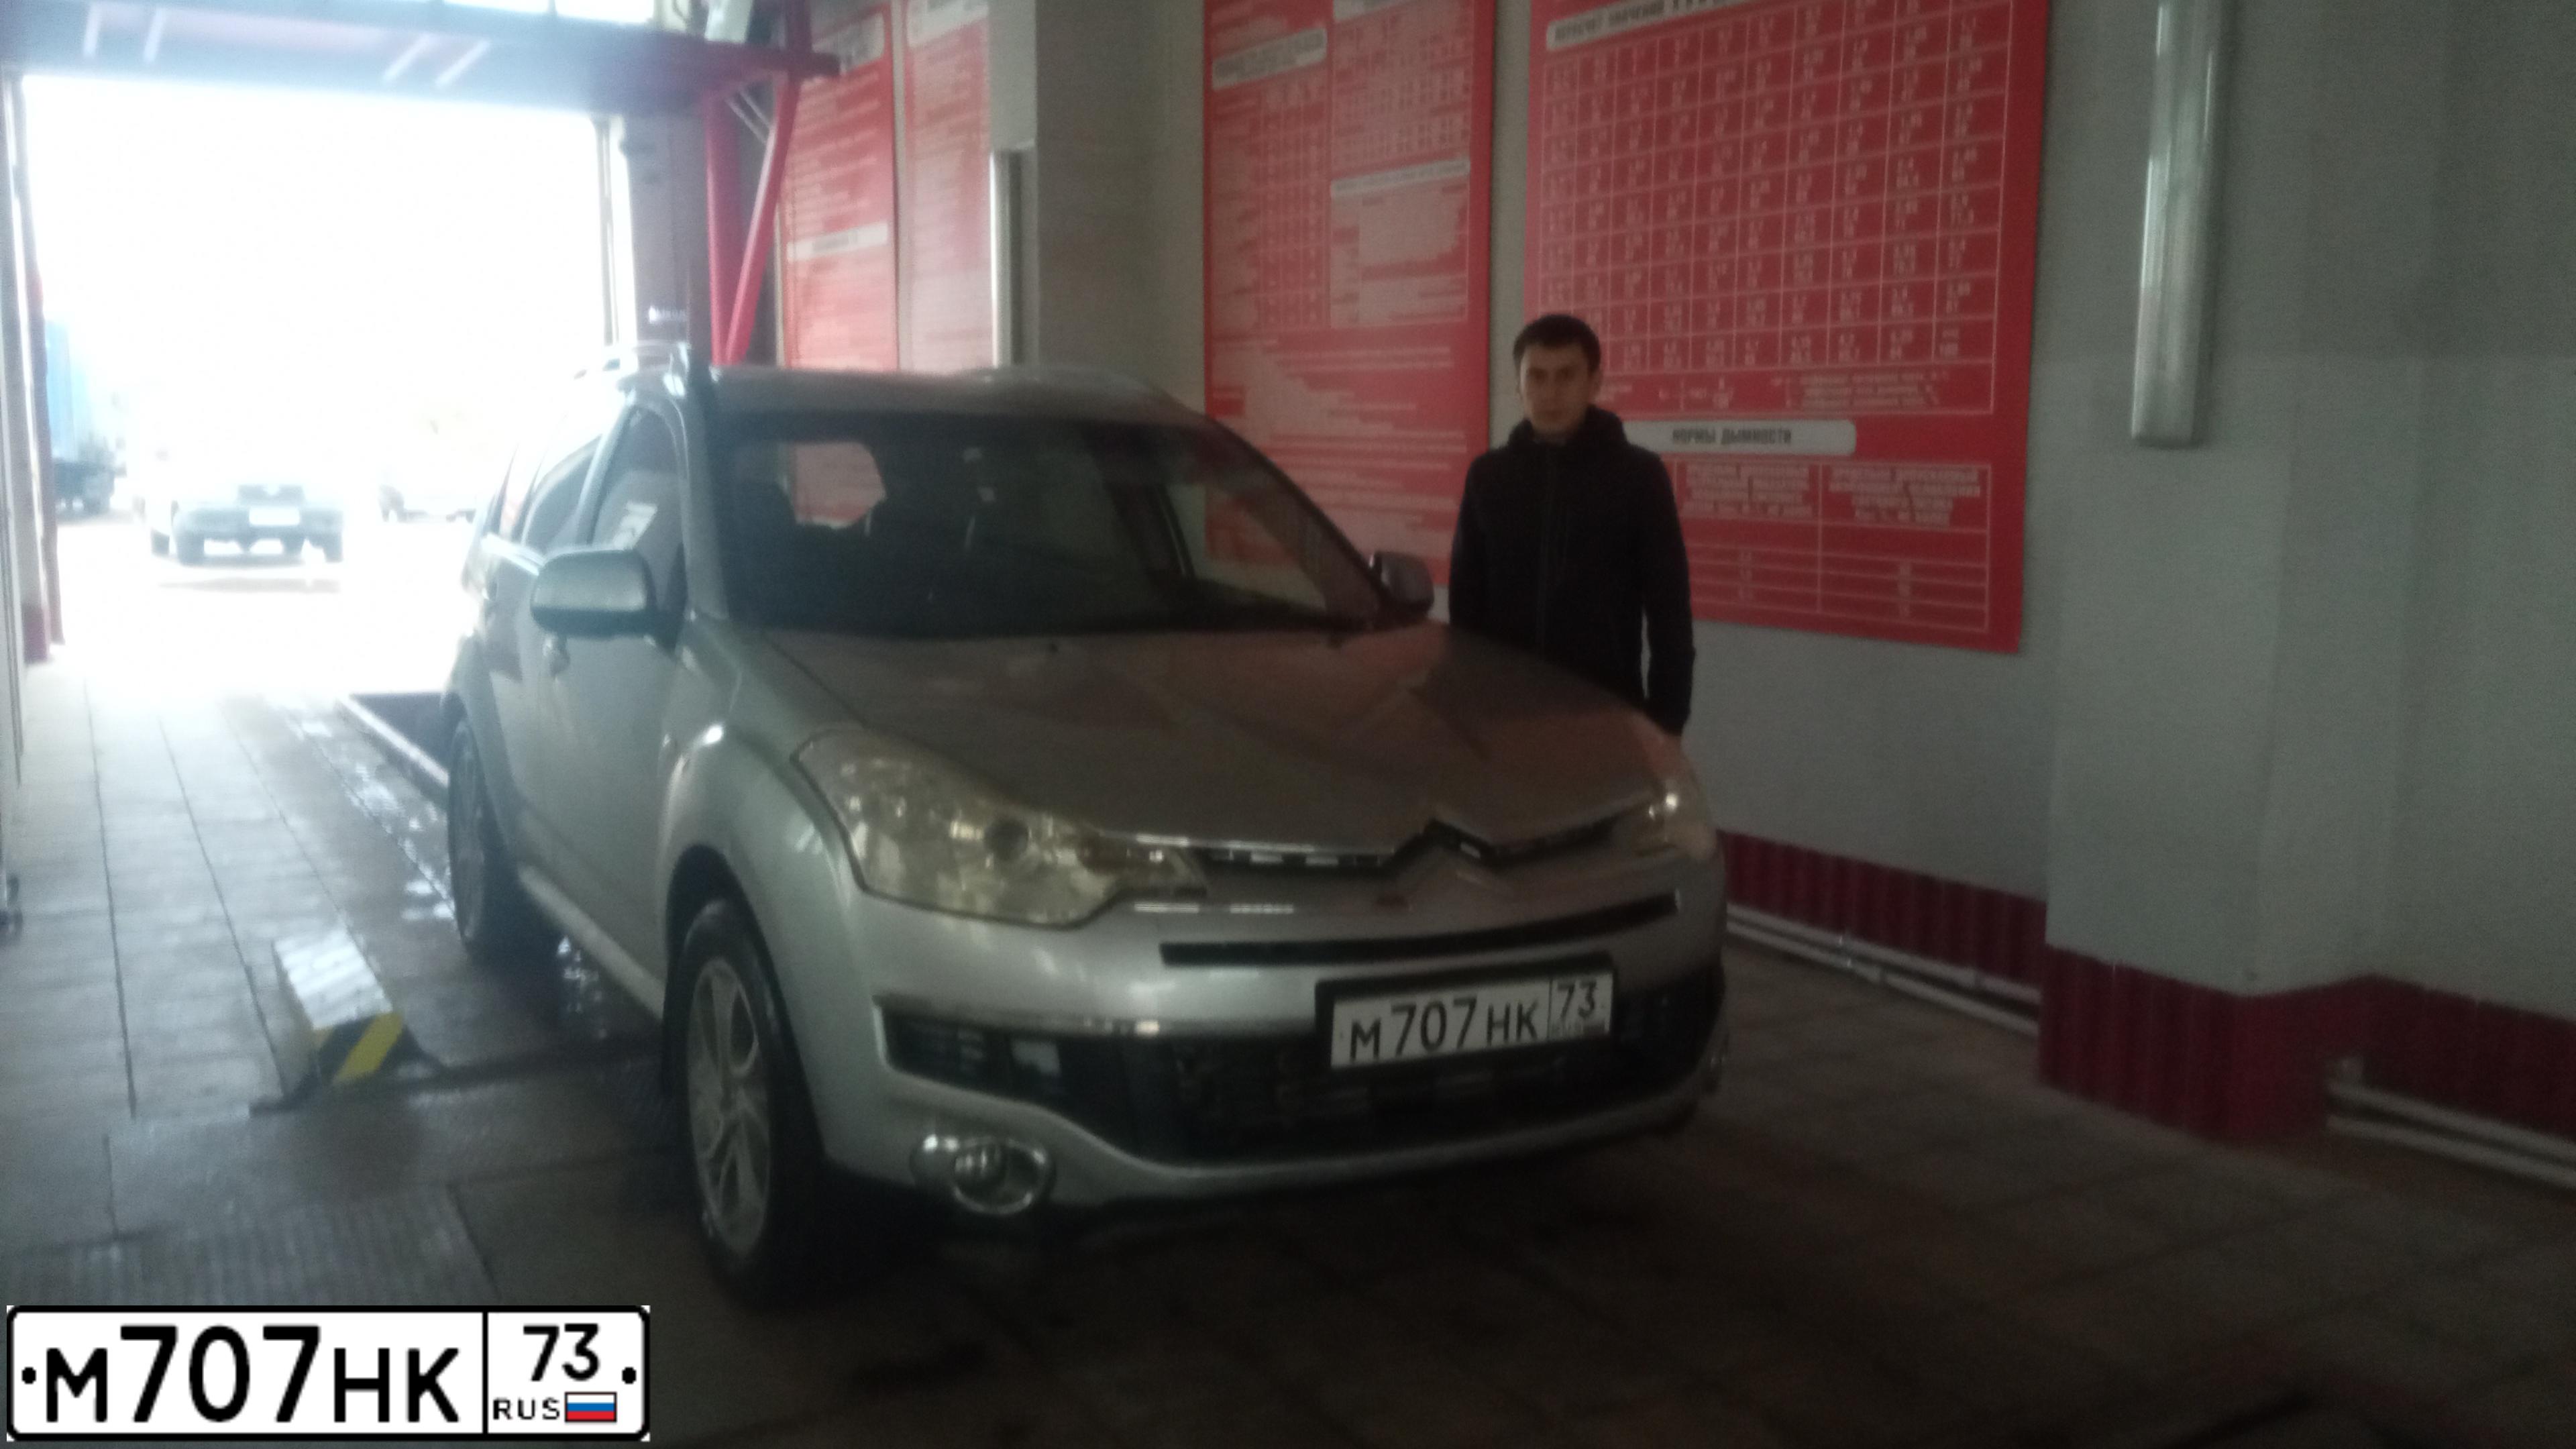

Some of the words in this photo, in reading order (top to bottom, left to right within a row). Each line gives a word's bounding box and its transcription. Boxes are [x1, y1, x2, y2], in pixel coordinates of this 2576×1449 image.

[1672, 428, 1715, 443] НОРМЫ
[1721, 428, 1792, 444] ДЫМНОСТИ
[1350, 996, 1539, 1063] М707НК
[1556, 979, 1597, 1020] 73
